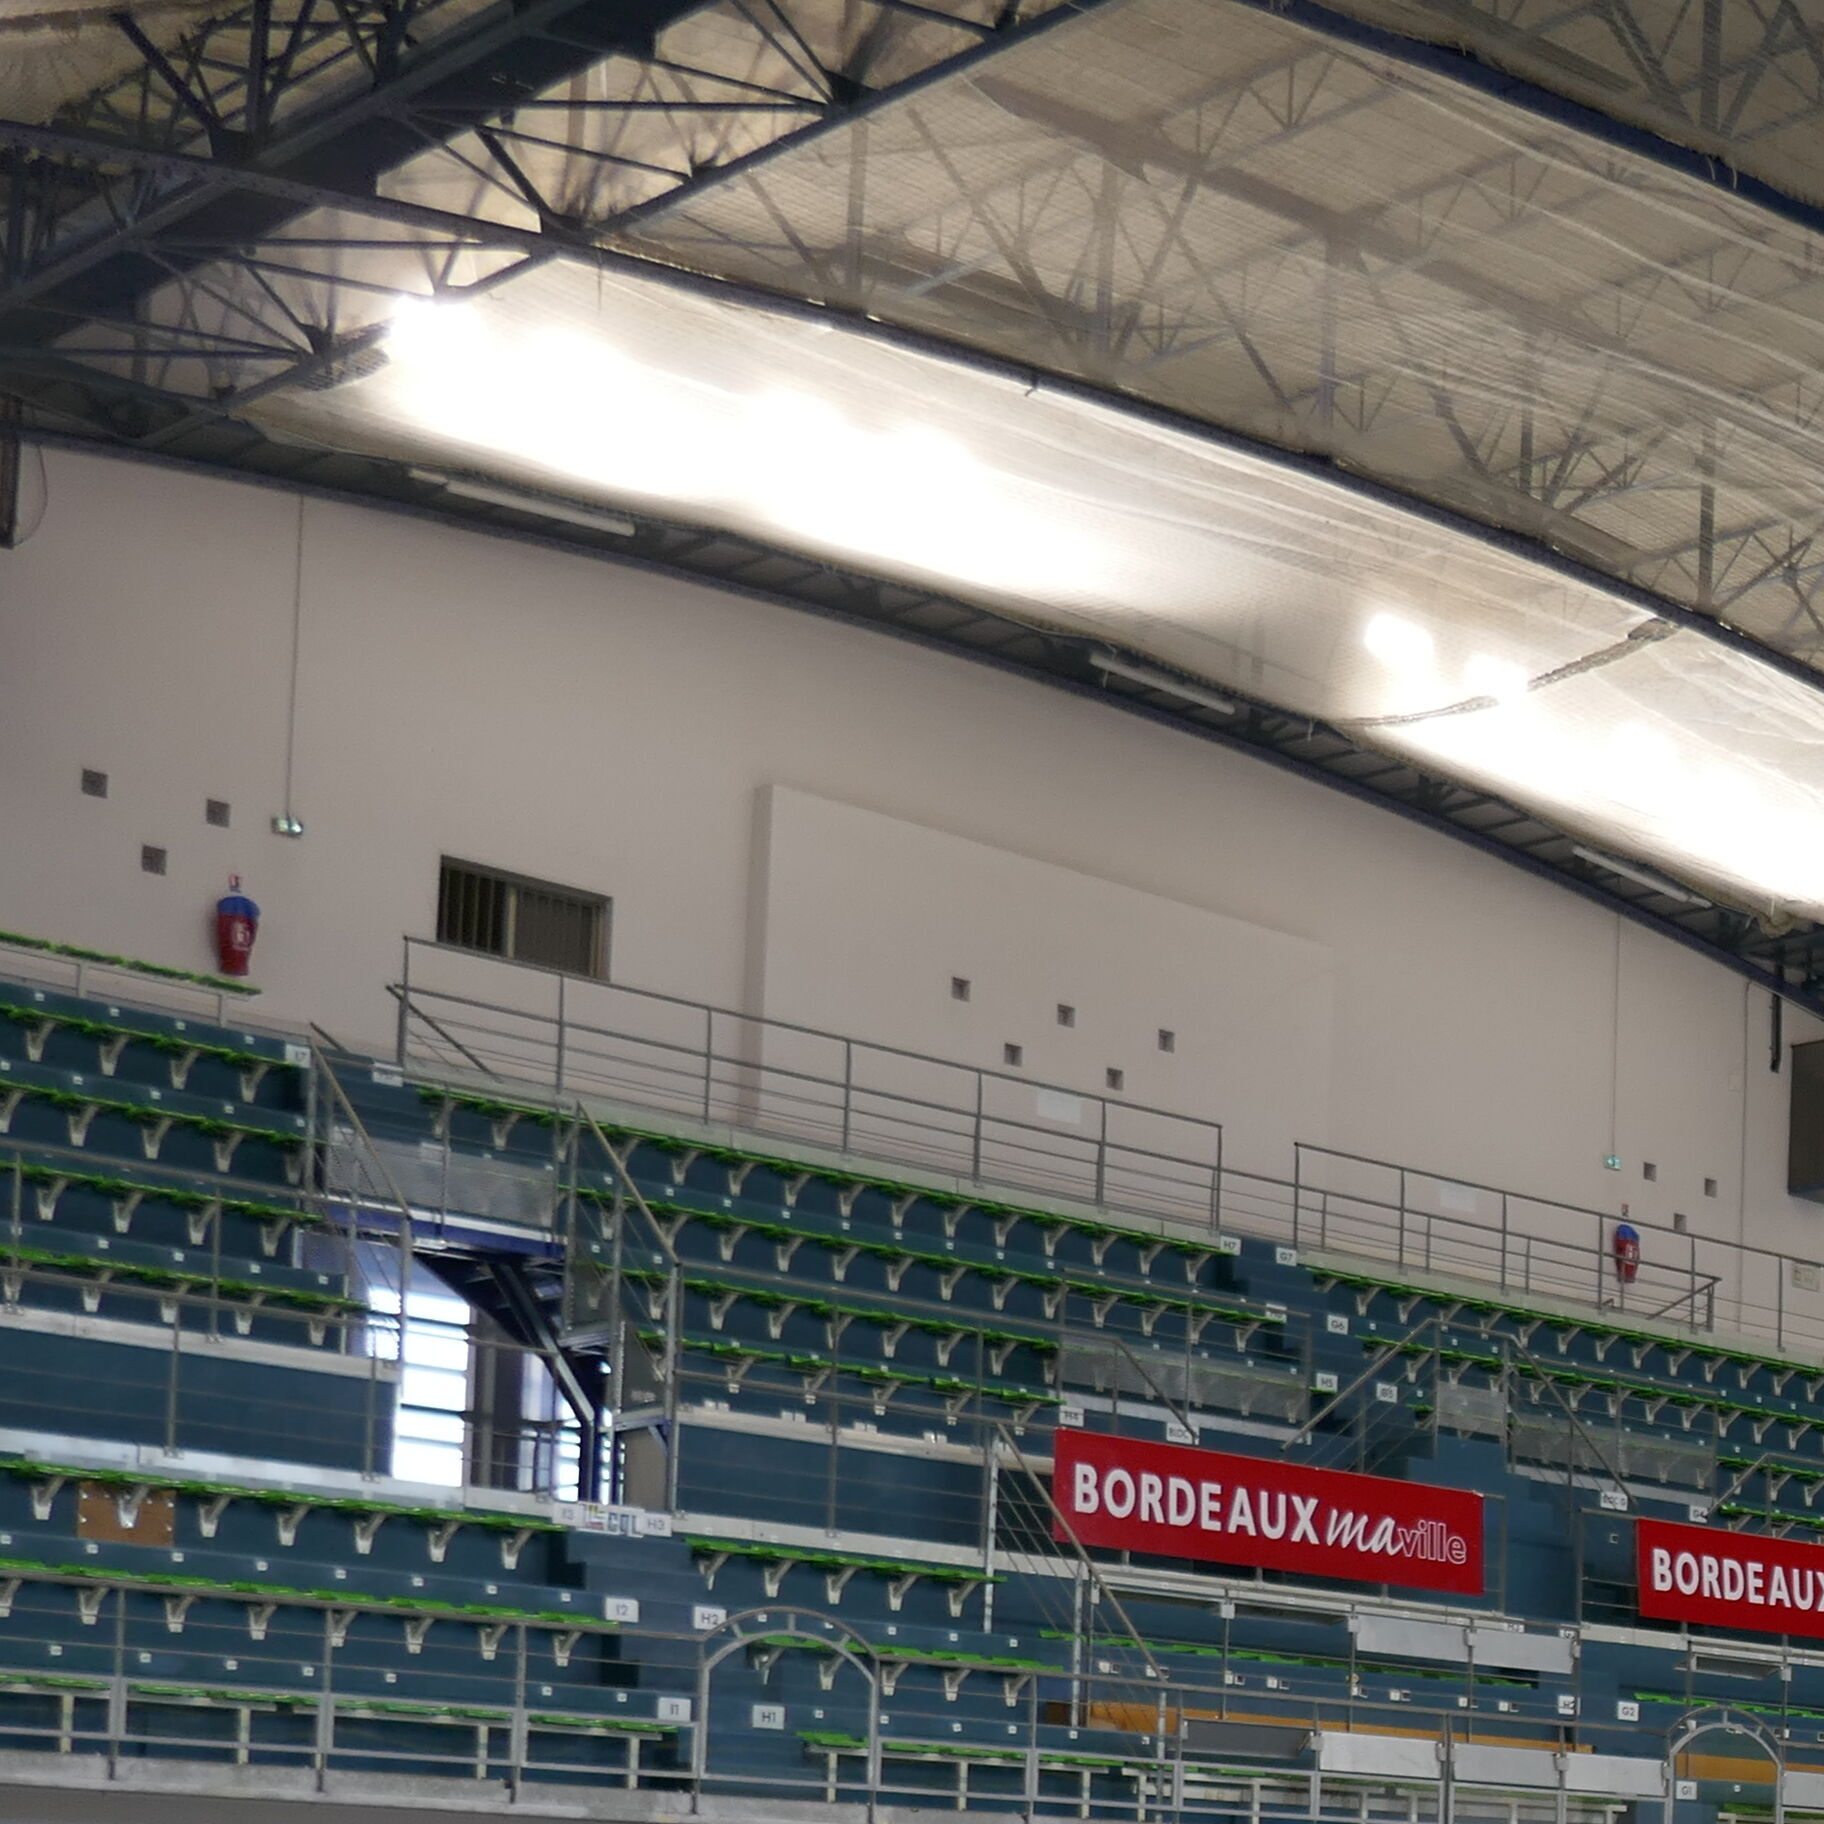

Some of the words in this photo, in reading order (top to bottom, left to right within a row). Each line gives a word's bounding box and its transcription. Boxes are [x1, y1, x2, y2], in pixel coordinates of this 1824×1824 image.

[1279, 1253, 1293, 1262] G7
[1073, 1462, 1320, 1545] BORDEAUX
[647, 1518, 666, 1530] H3
[701, 1613, 719, 1625] H2
[761, 1711, 777, 1723] H1
[1622, 1707, 1636, 1717] G2
